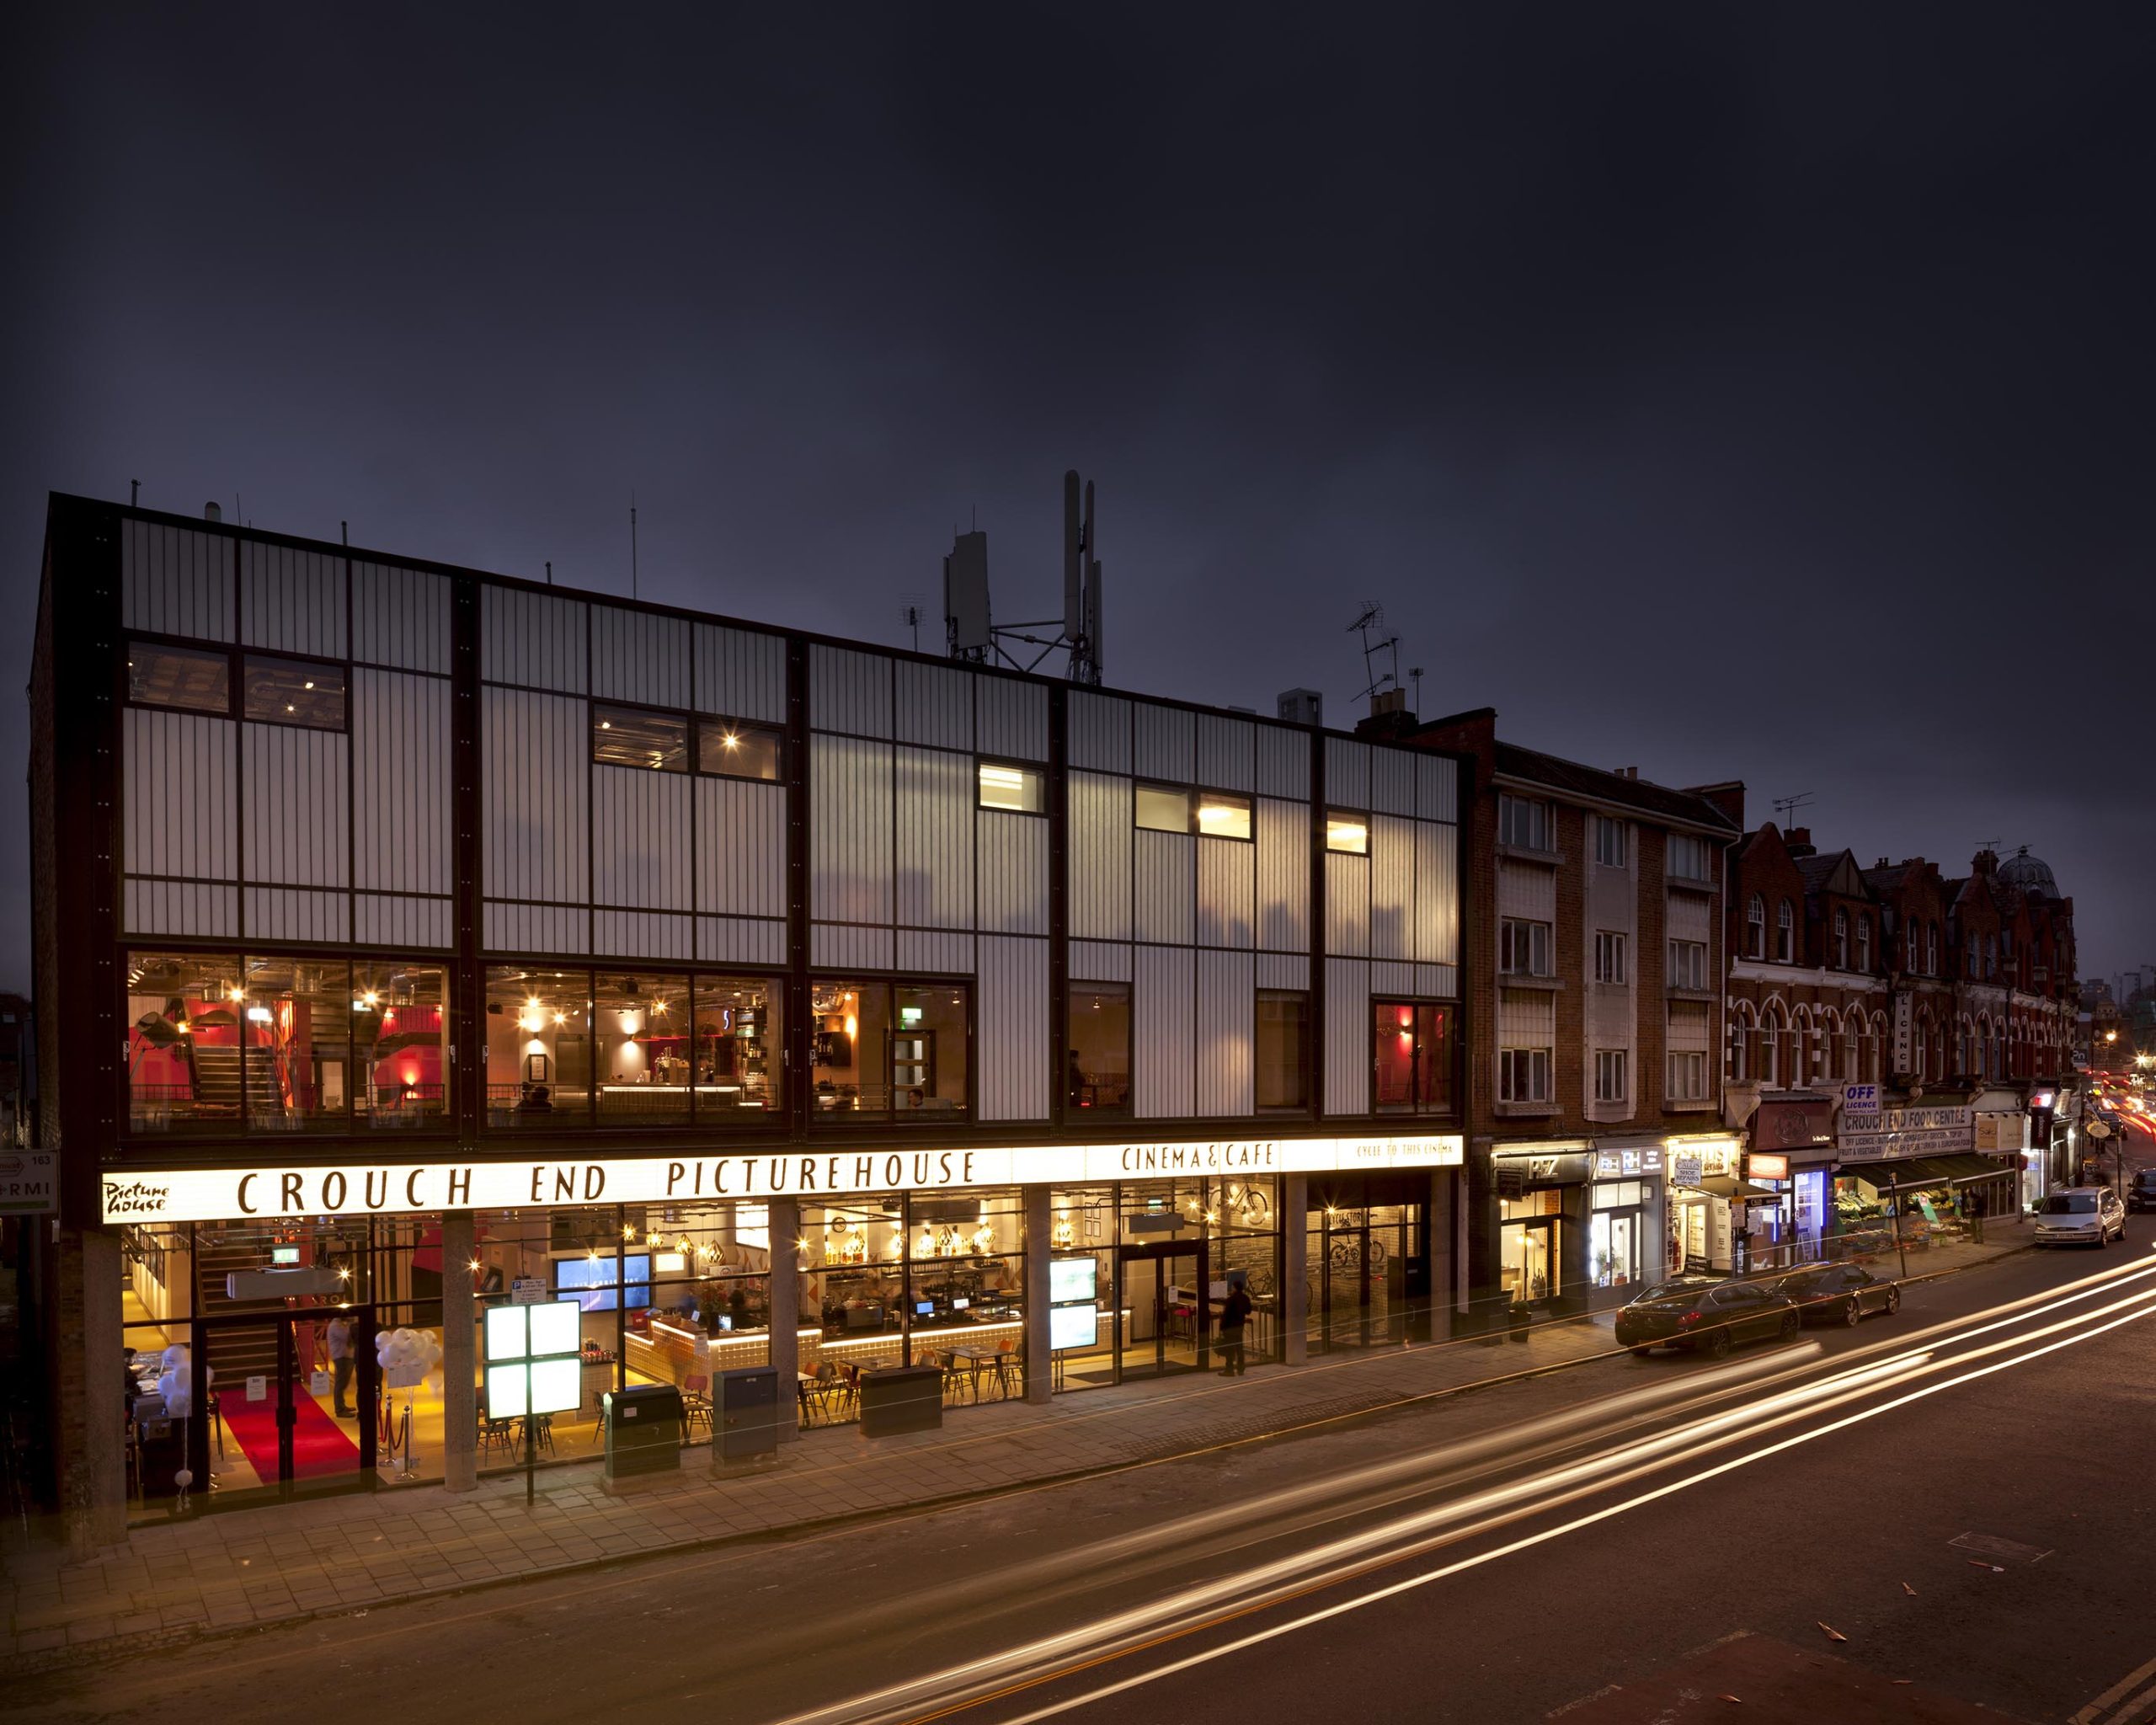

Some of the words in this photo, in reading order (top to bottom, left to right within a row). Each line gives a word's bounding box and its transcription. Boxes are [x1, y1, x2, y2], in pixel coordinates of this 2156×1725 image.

[1899, 997, 1908, 1071] LICENCE
[1847, 1086, 1876, 1099] OFF
[1888, 1112, 1907, 1129] END
[1909, 1110, 1932, 1127] FOOD
[1934, 1108, 1966, 1126] CENTRE
[1122, 1146, 1200, 1171] CINEMA
[1209, 1145, 1217, 1167] &
[1225, 1143, 1273, 1166] CAFE
[1357, 1145, 1381, 1157] CYCLE
[1387, 1145, 1397, 1156] TO
[1402, 1143, 1421, 1156] THIS
[1424, 1142, 1453, 1154] CINEMA
[32, 1155, 51, 1166] 163
[103, 1182, 169, 1199] Picture
[237, 1168, 472, 1213] CROUCH
[531, 1166, 606, 1202] END
[666, 1151, 974, 1196] PICTUREHOUSE
[108, 1194, 166, 1214] house
